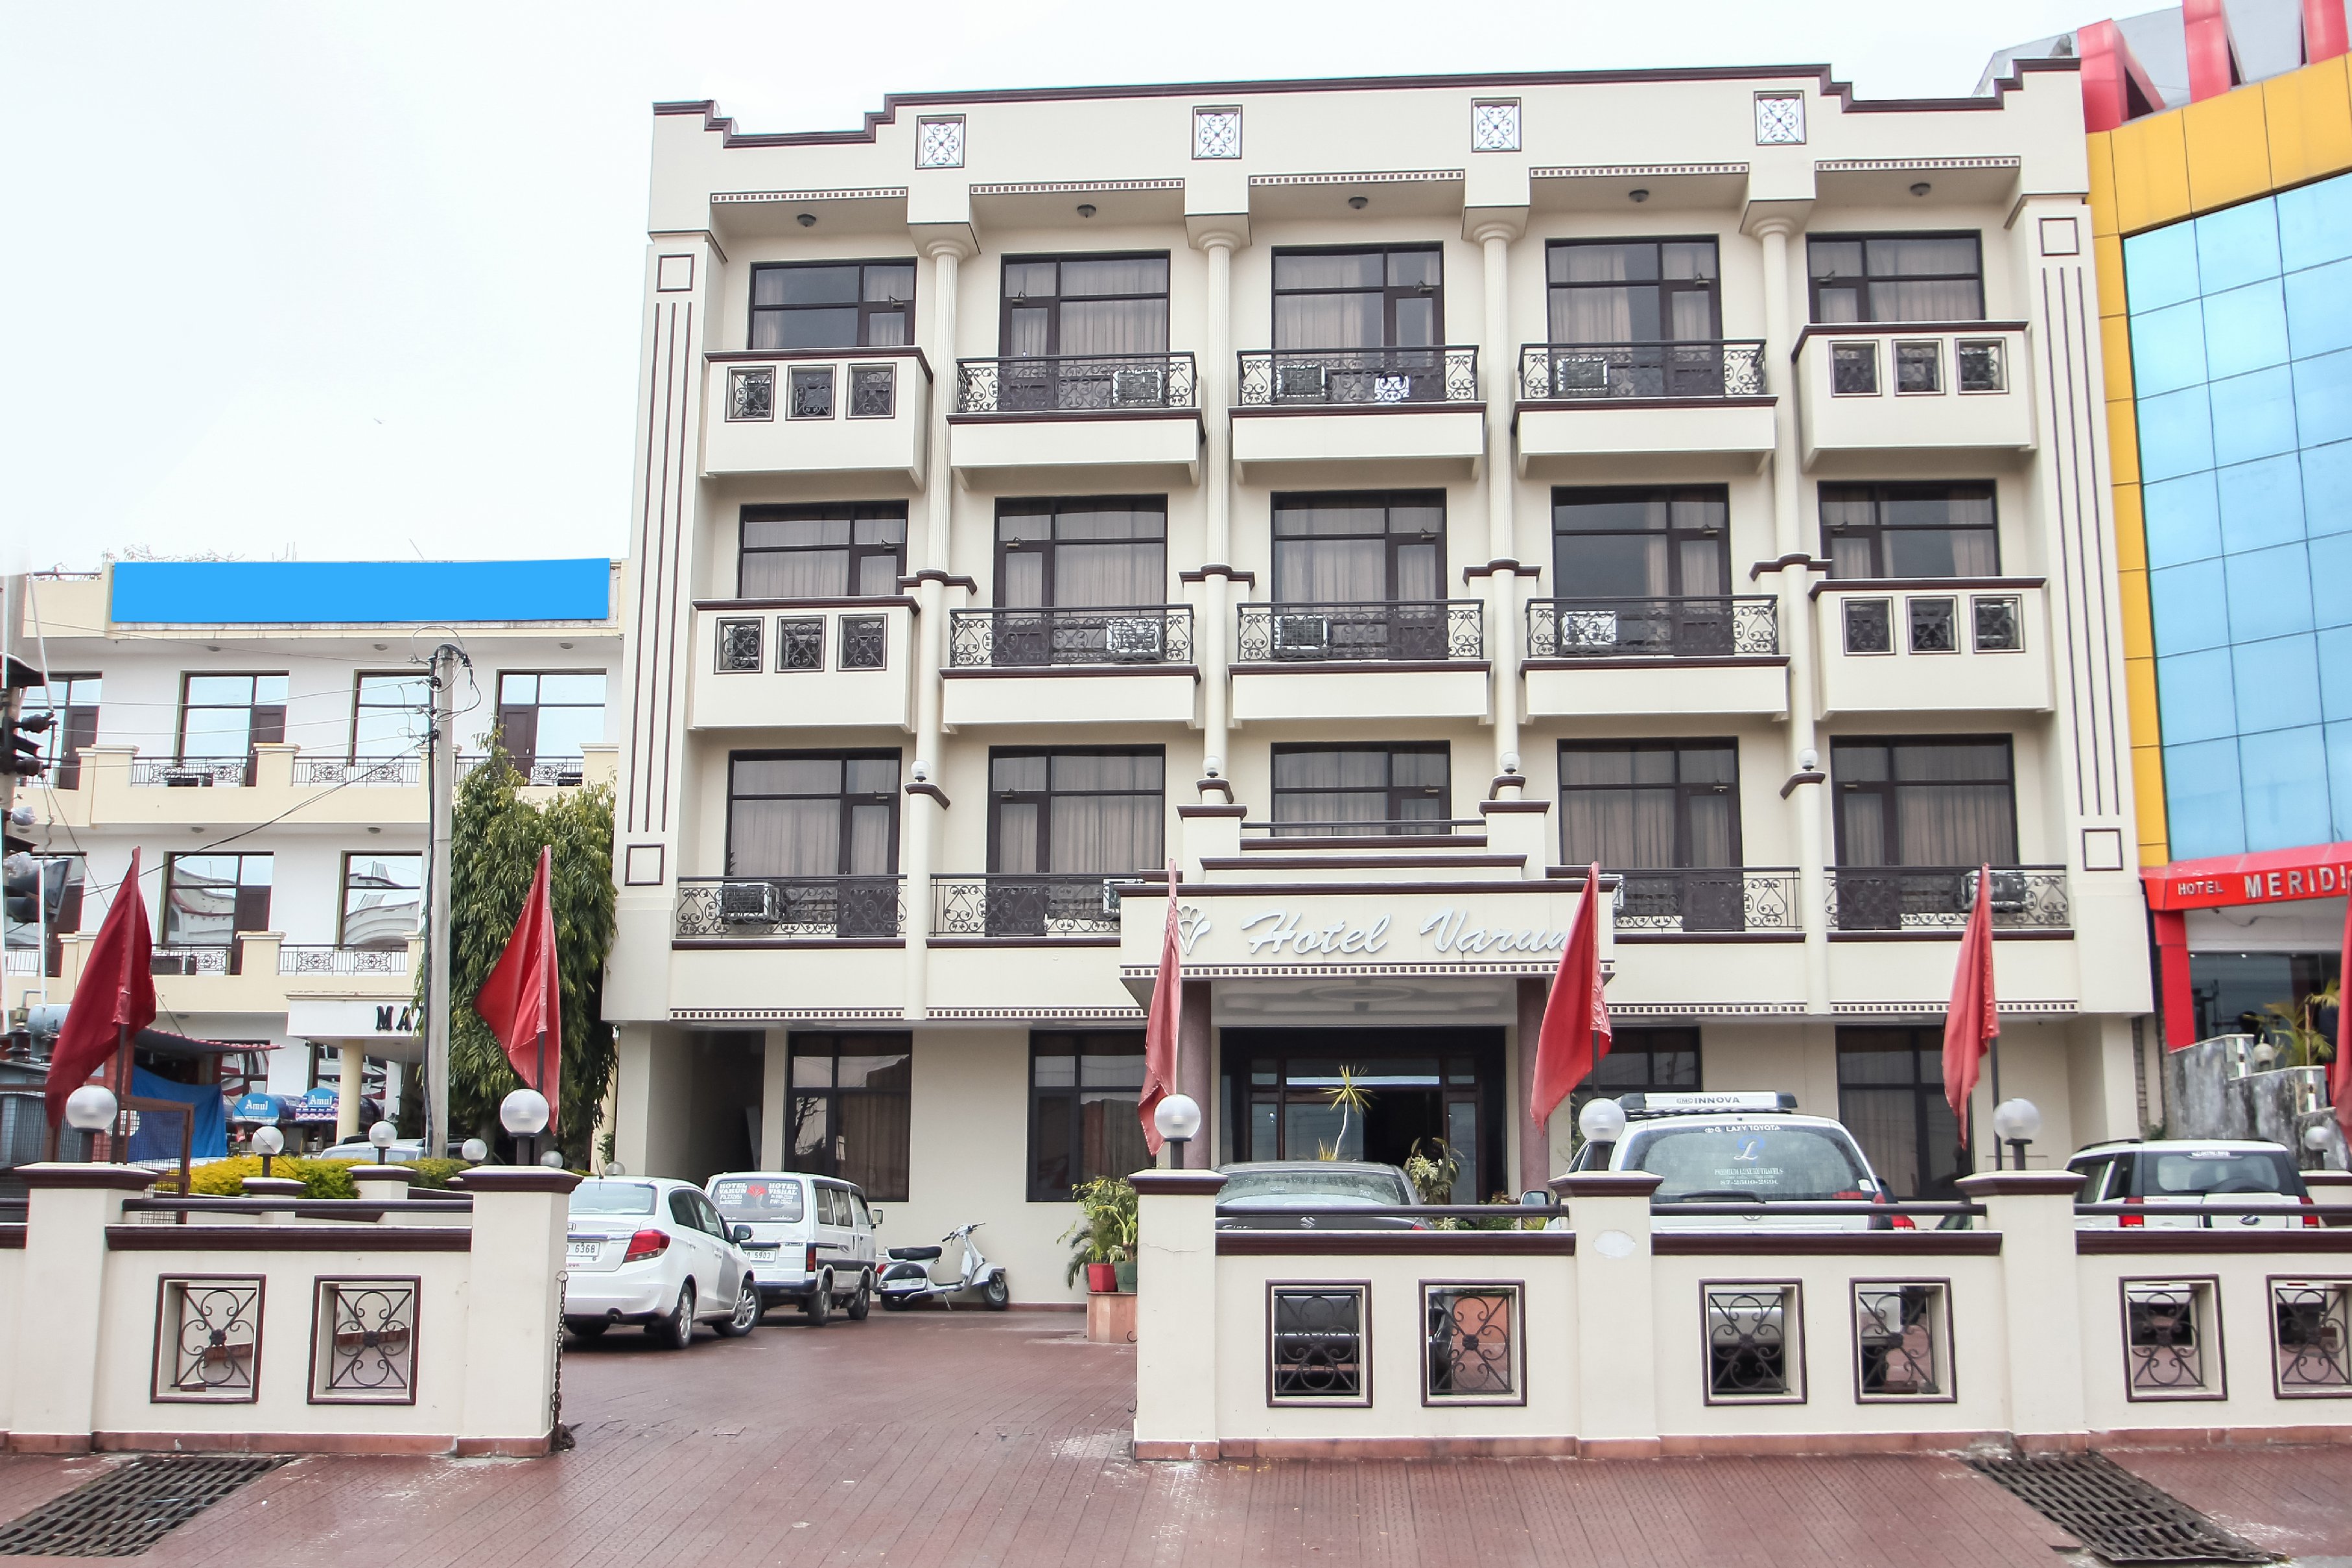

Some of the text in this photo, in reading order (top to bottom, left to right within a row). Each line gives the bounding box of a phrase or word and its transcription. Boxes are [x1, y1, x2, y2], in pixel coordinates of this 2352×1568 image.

[2178, 865, 2347, 899] HOTEL MERIDI
[1241, 908, 1573, 955] Hotel Varun
[245, 1099, 268, 1110] Amul
[309, 1095, 332, 1106] Amul
[575, 1245, 595, 1253] 6368
